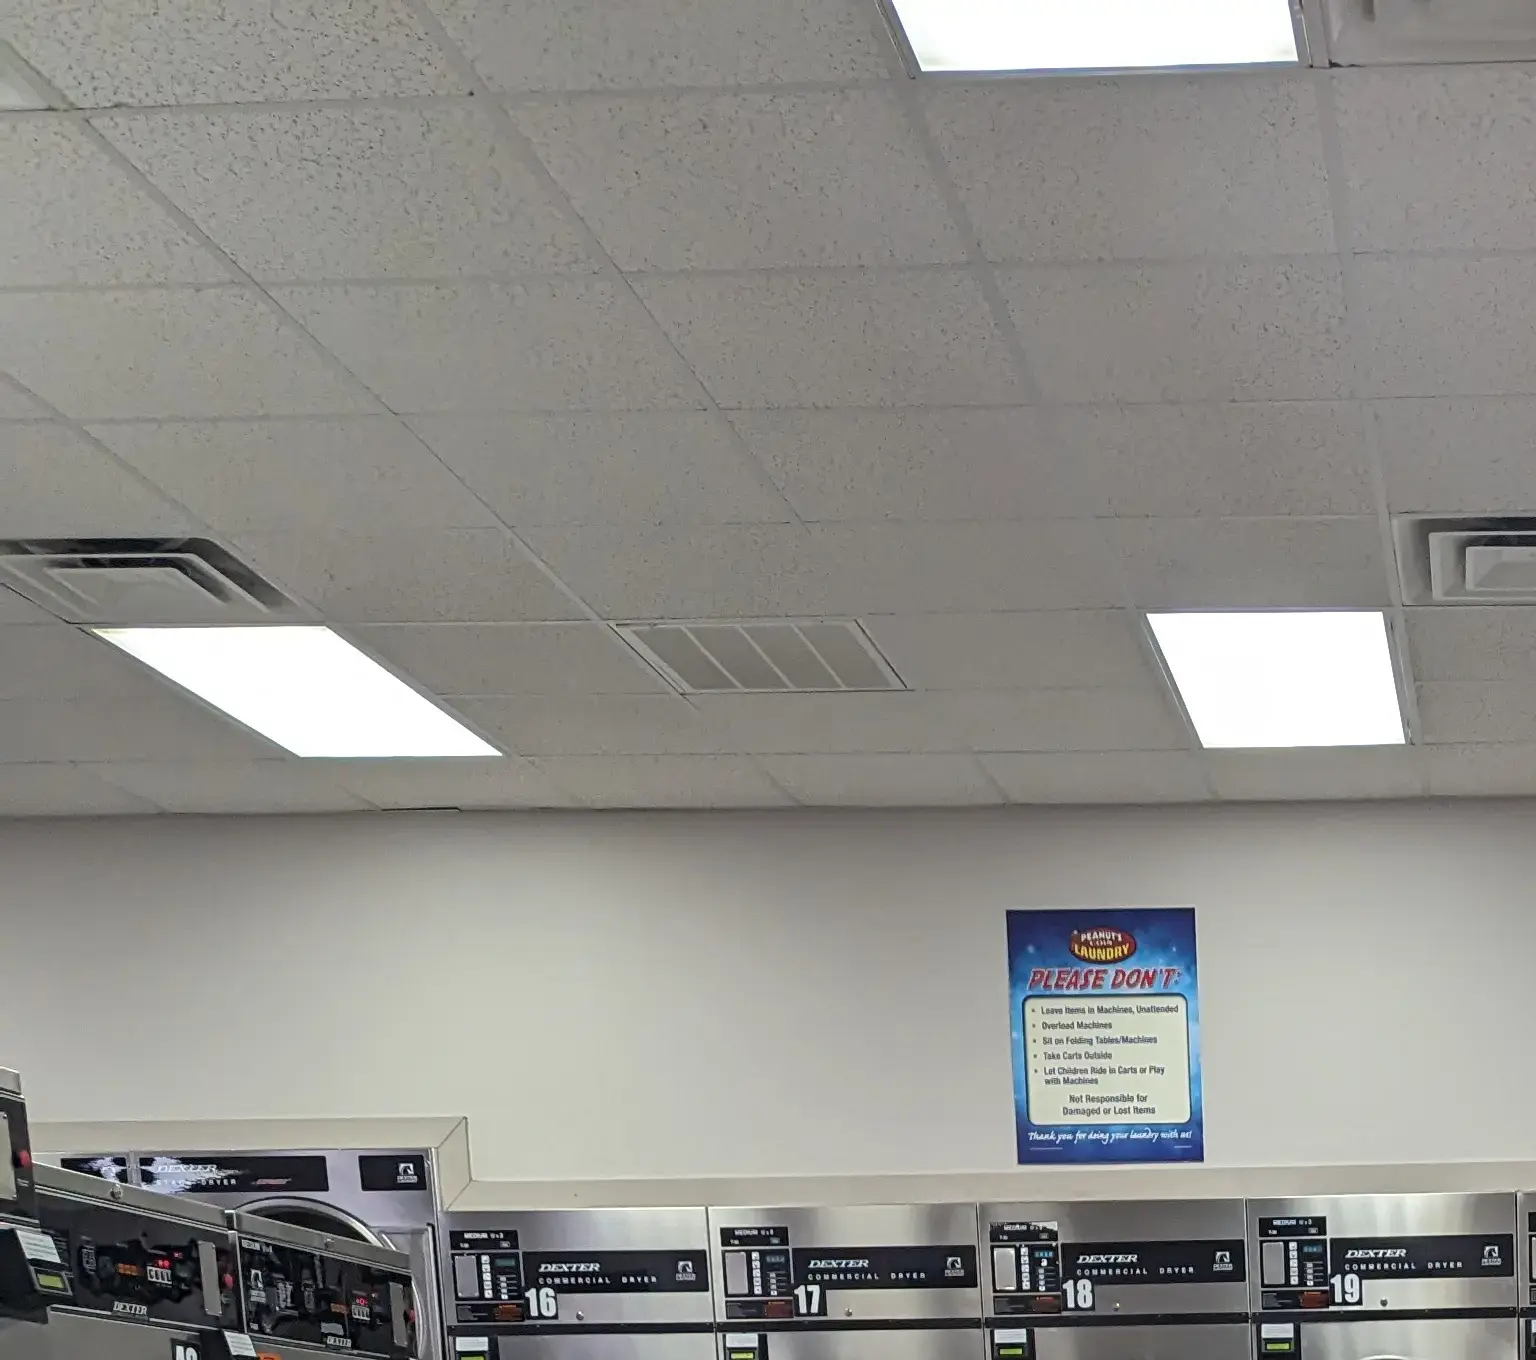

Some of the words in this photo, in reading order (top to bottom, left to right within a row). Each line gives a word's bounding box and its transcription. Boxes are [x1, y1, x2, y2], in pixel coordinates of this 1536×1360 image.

[1074, 943, 1130, 960] LAUNDRY
[1028, 968, 1109, 991] PLEASE
[1111, 967, 1182, 989] DON'T:
[1041, 1006, 1063, 1015] Leave
[1065, 1006, 1086, 1014] Items
[1088, 1006, 1095, 1014] in
[1097, 1005, 1135, 1015] Machines,
[1136, 1005, 1179, 1013] Unattended
[1042, 1022, 1075, 1030] Overload
[1077, 1021, 1112, 1030] Machines
[1043, 1037, 1053, 1045] Sit
[1066, 1036, 1093, 1046] Folding
[1095, 1036, 1158, 1045] Tables/Machines
[1043, 1052, 1061, 1060] Take
[1063, 1052, 1082, 1060] Carts
[1084, 1052, 1112, 1060] Outside
[1044, 1067, 1056, 1075] Let
[1058, 1066, 1089, 1074] Children
[1090, 1066, 1107, 1074] Ride
[1109, 1066, 1116, 1074] in
[1118, 1066, 1137, 1074] Carts
[1149, 1065, 1165, 1075] Play
[1045, 1077, 1061, 1085] with
[1063, 1077, 1099, 1085] Machines
[1069, 1094, 1083, 1104] Not
[1085, 1094, 1134, 1105] Responsible
[1137, 1094, 1148, 1102] for
[1062, 1106, 1101, 1117] Damaged
[1114, 1106, 1131, 1115] Lost
[1133, 1106, 1156, 1115] Items
[1028, 1130, 1056, 1141] Thank
[1057, 1132, 1073, 1145] you
[1074, 1130, 1087, 1145] for
[1088, 1130, 1109, 1145] doing
[1110, 1132, 1129, 1144] your
[1130, 1127, 1159, 1143] laundry
[1160, 1129, 1179, 1139] with
[201, 1178, 237, 1187] DRYER
[1345, 1248, 1407, 1258] DEXTER
[808, 1259, 870, 1268] DEXTER
[1077, 1254, 1139, 1264] DEXTER
[538, 1262, 601, 1272] DEXTER
[1077, 1267, 1148, 1276] COMMERCIAL
[1160, 1266, 1195, 1274] DRYER
[1345, 1262, 1417, 1271] COMMERCIAL
[1428, 1261, 1463, 1269] DRYER
[538, 1276, 611, 1285] COMMERCIAL
[621, 1275, 657, 1283] DRYER
[808, 1272, 880, 1281] COMMERCIAL
[1330, 1273, 1360, 1303] 19
[1062, 1278, 1093, 1309] 18
[524, 1287, 557, 1317] 16
[793, 1285, 821, 1314] 17
[113, 1301, 148, 1316] DEXTER
